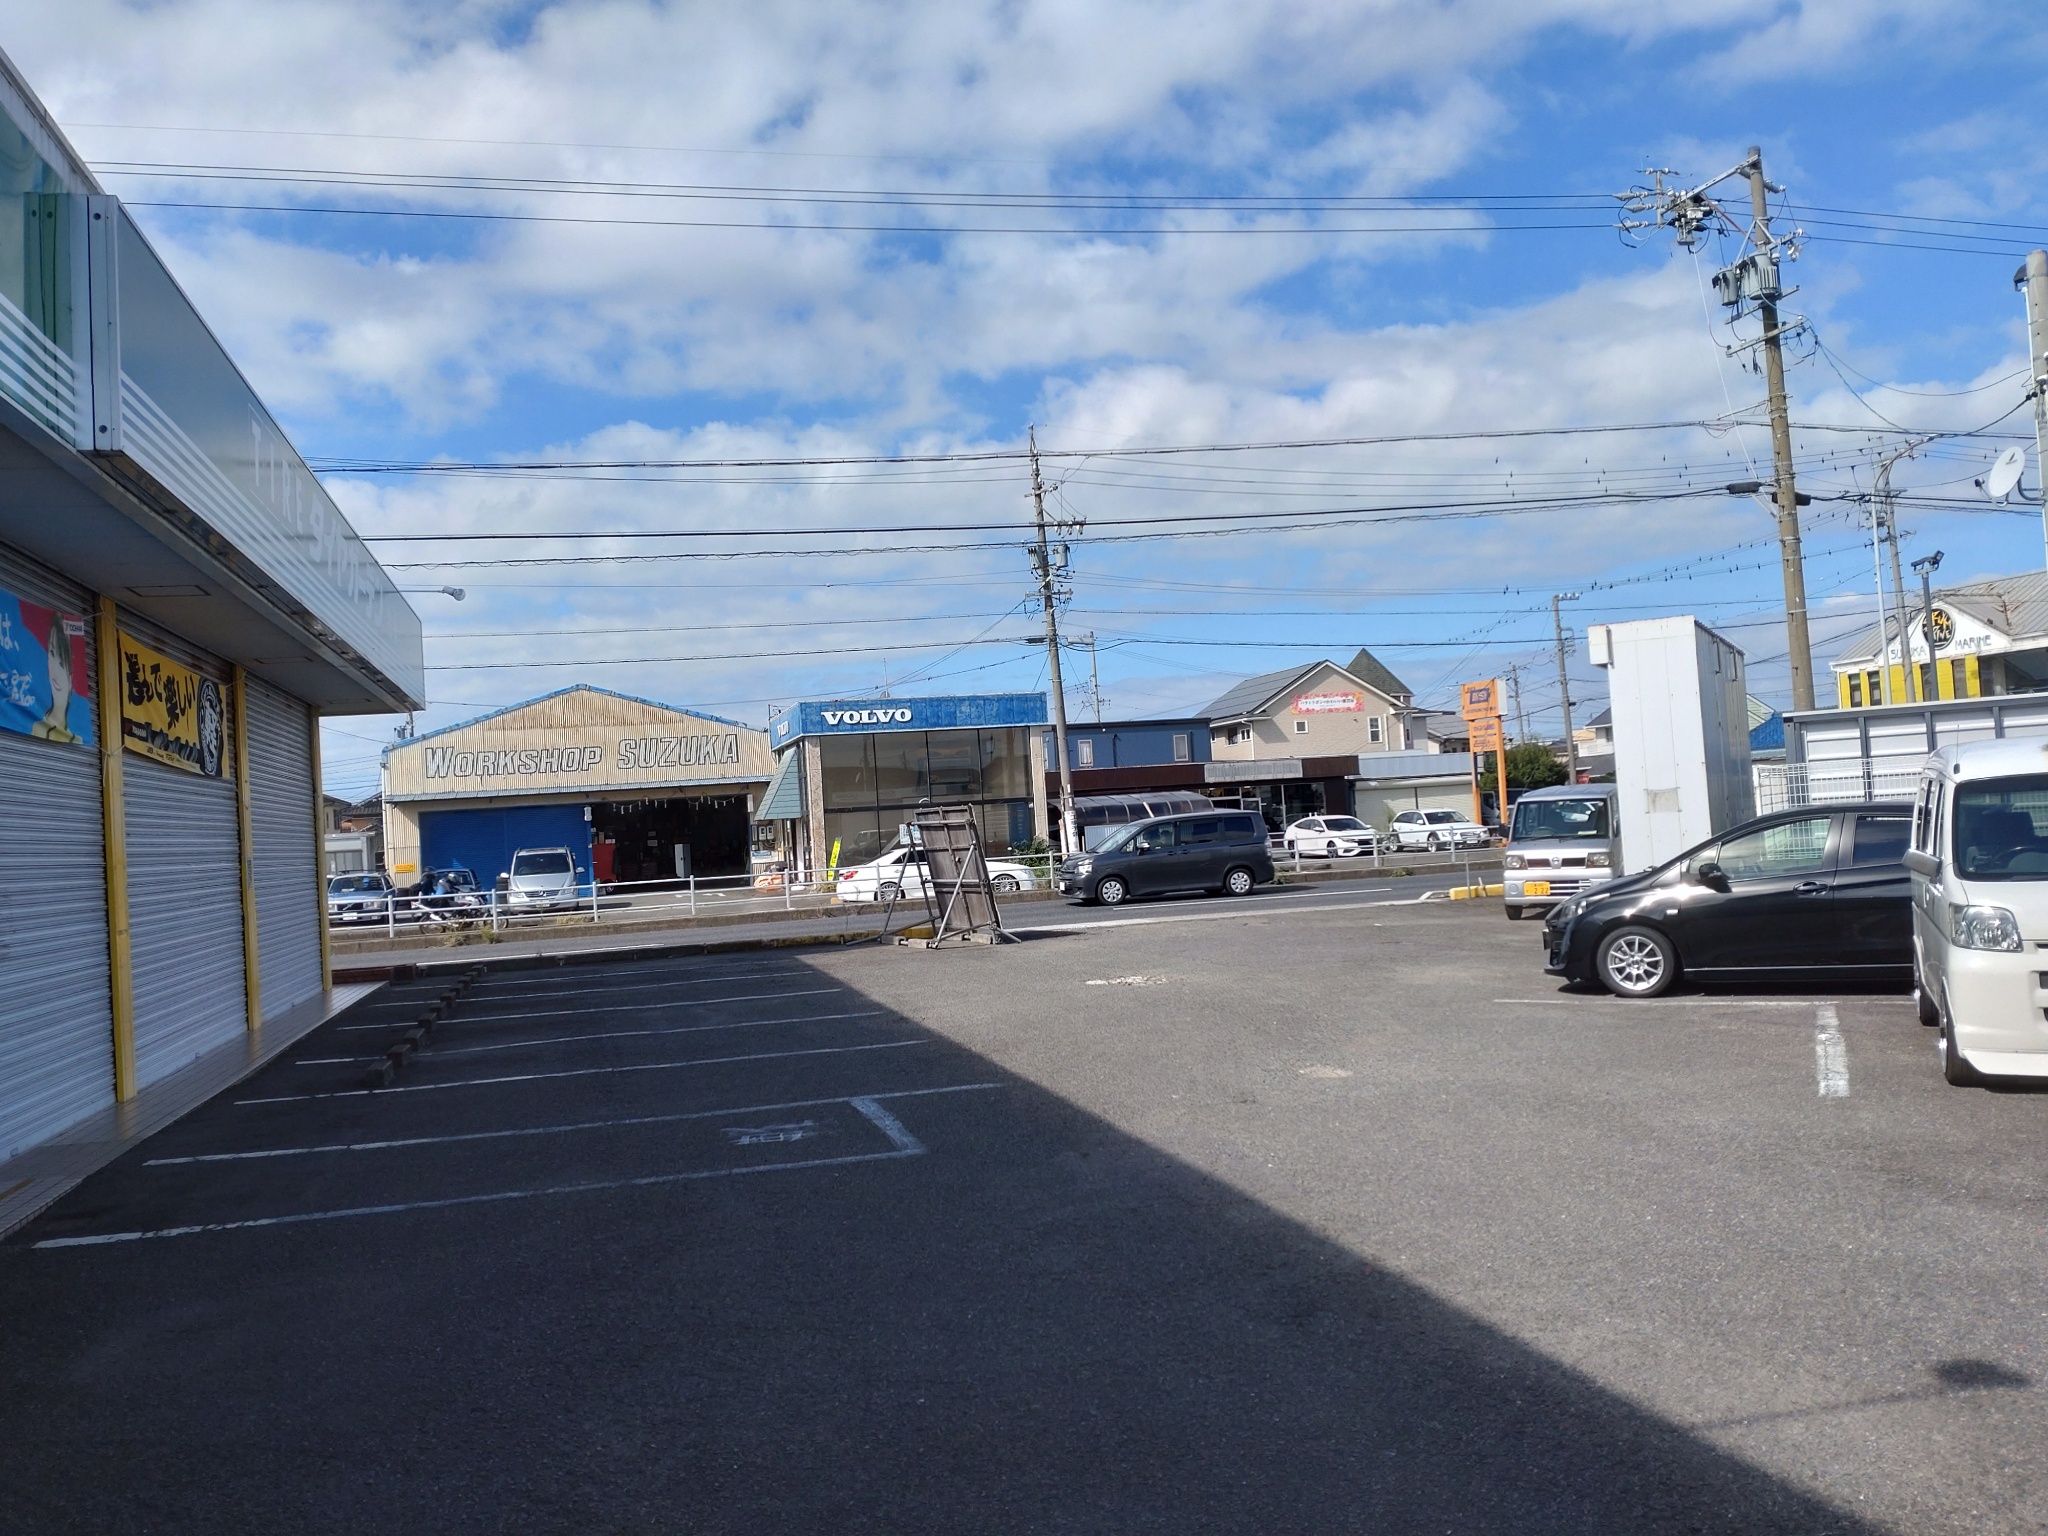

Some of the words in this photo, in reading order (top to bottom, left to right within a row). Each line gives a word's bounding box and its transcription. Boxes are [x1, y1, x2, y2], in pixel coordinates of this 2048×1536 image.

[251, 418, 303, 535] TIRE
[1955, 635, 1992, 650] MARINE
[821, 708, 912, 725] VOLVO
[617, 733, 740, 770] SUZUKA
